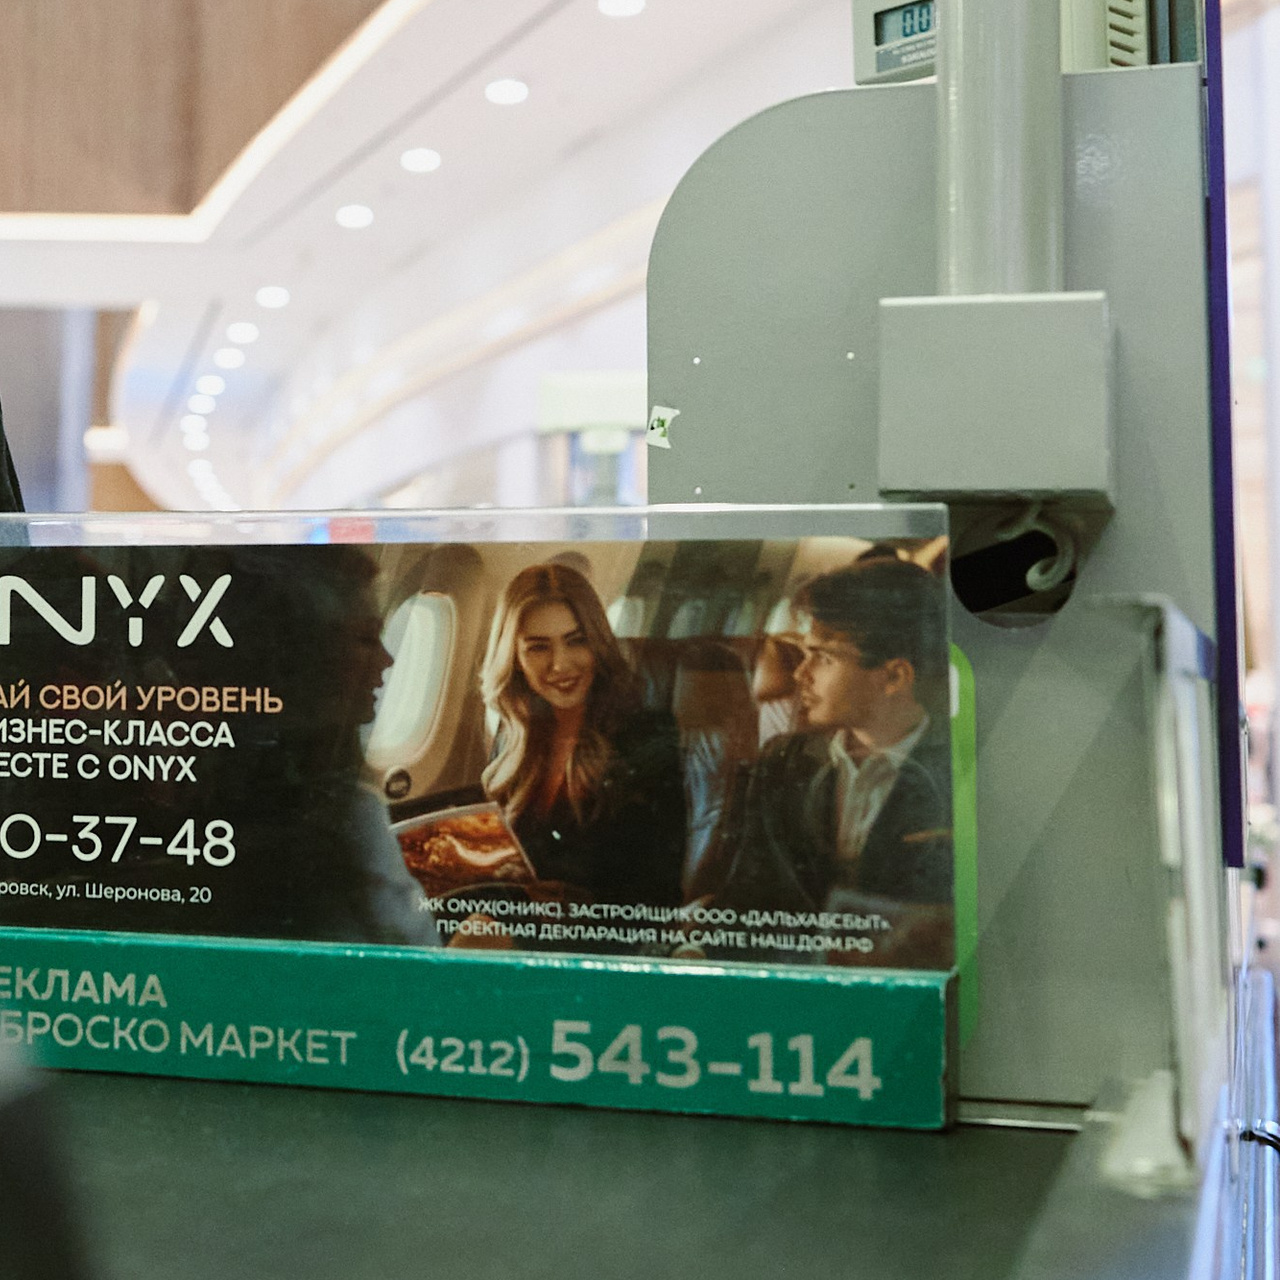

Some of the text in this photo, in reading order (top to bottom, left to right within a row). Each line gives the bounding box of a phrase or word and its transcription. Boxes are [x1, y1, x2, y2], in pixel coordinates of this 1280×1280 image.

[39, 679, 127, 710] СВОЙ
[136, 685, 283, 714] УРОВЕНЬ
[77, 754, 100, 780] С
[108, 754, 197, 782] ONYX
[56, 884, 80, 901] ул.
[85, 883, 185, 905] Шеронова,
[189, 887, 213, 904] 20
[419, 898, 444, 913] ЖК
[568, 903, 689, 923] ЗАСТРОЙЩИК
[693, 907, 737, 924] ООО
[436, 919, 536, 937] ПРОЕКТНАЯ
[538, 923, 658, 944] ДЕКЛАРАЦИЯ
[661, 929, 686, 944] НА
[689, 927, 747, 948] САЙТЕ
[0, 1010, 170, 1053] БРОСКО
[180, 1021, 357, 1065] МАРКЕТ
[396, 1019, 883, 1102] (4212) 543-114
